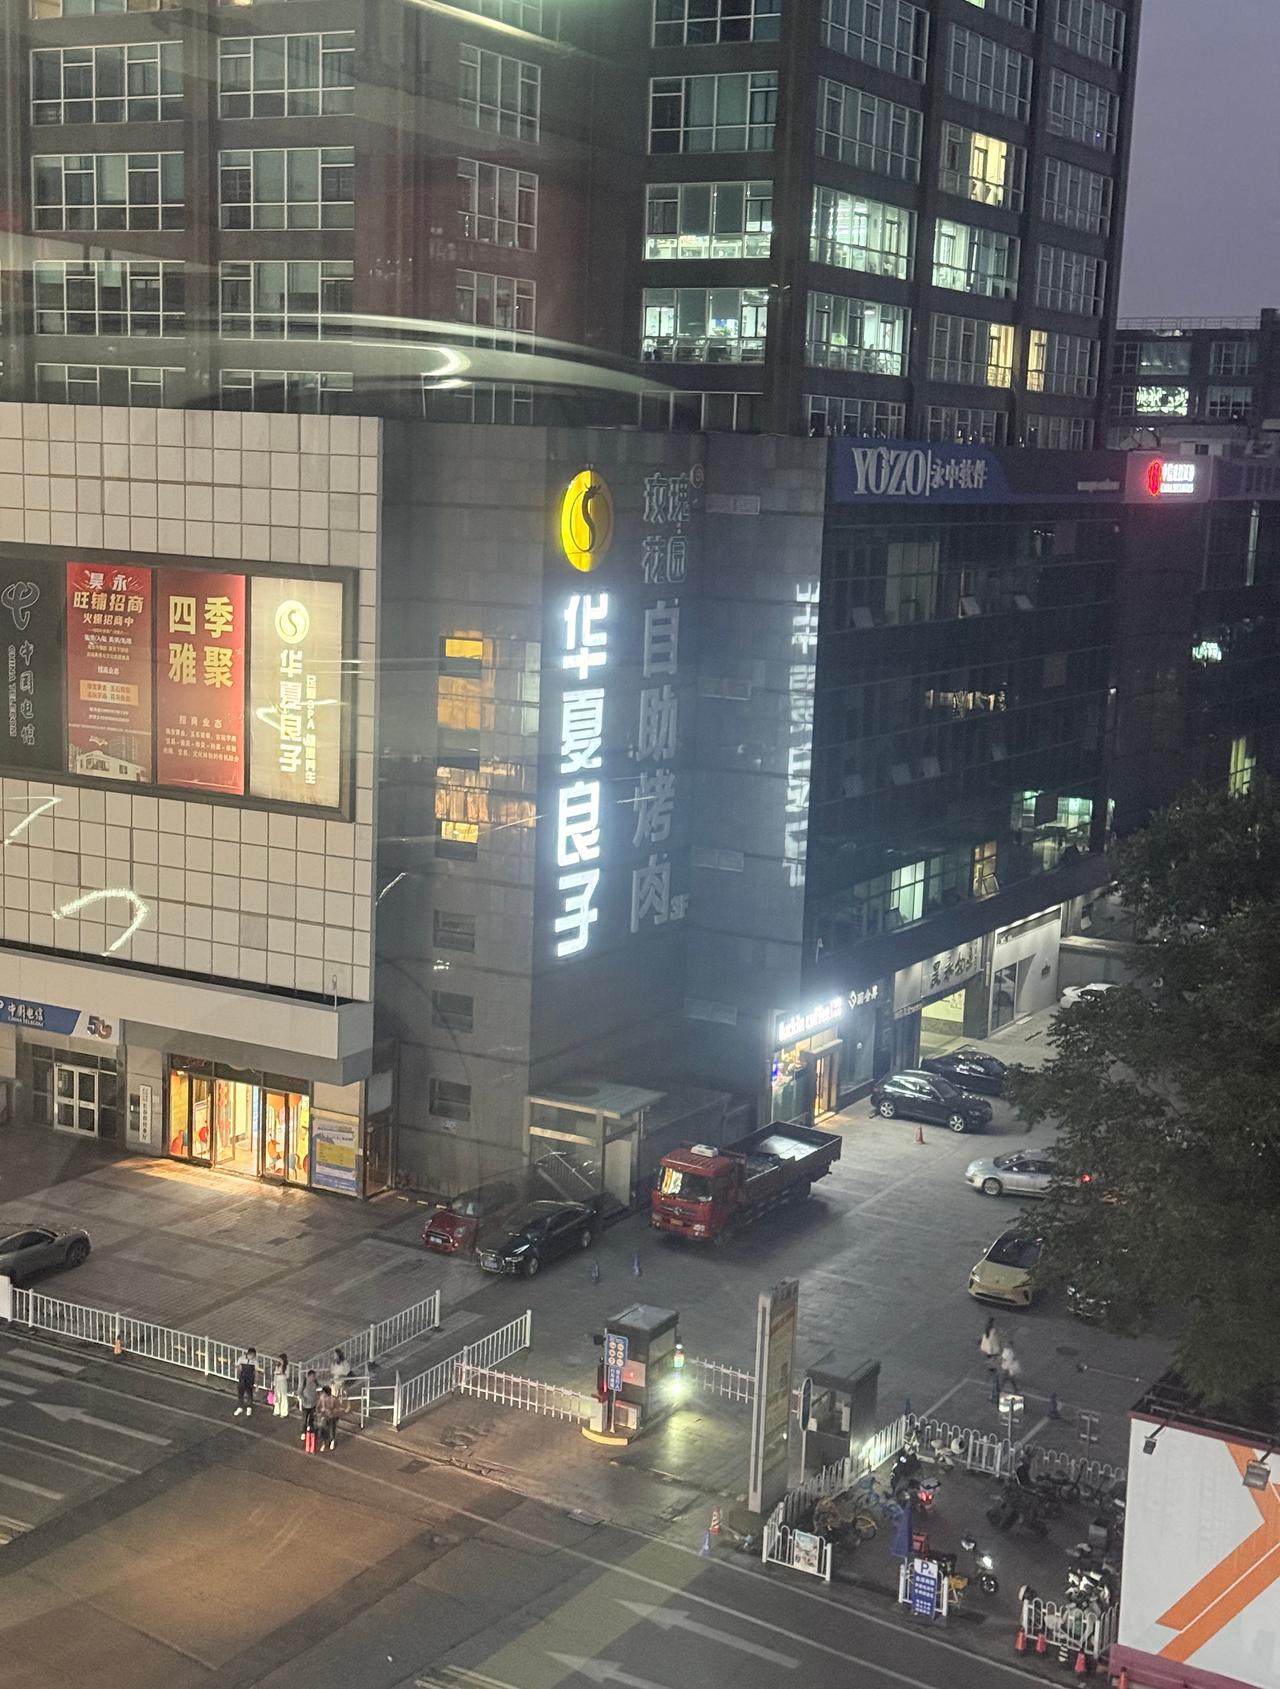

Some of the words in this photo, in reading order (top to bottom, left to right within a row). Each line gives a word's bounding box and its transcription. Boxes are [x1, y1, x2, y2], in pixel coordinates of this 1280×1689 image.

[852, 447, 926, 495] YOZO
[931, 458, 988, 489] 永中软件
[642, 472, 690, 524] 玫瑰
[641, 535, 689, 584] 花园
[73, 591, 144, 613] 旺铺招商
[82, 612, 134, 628] 火爆招商中
[168, 595, 235, 638] 四季
[168, 642, 234, 689] 雅聚
[19, 639, 36, 746] 中国电信
[278, 649, 304, 774] 华夏良子
[179, 715, 223, 729] 招商业态
[554, 592, 608, 959] 华夏良子
[630, 597, 681, 934] 自助烤肉
[8, 1002, 44, 1021] 中国电信
[921, 1562, 929, 1573] P
